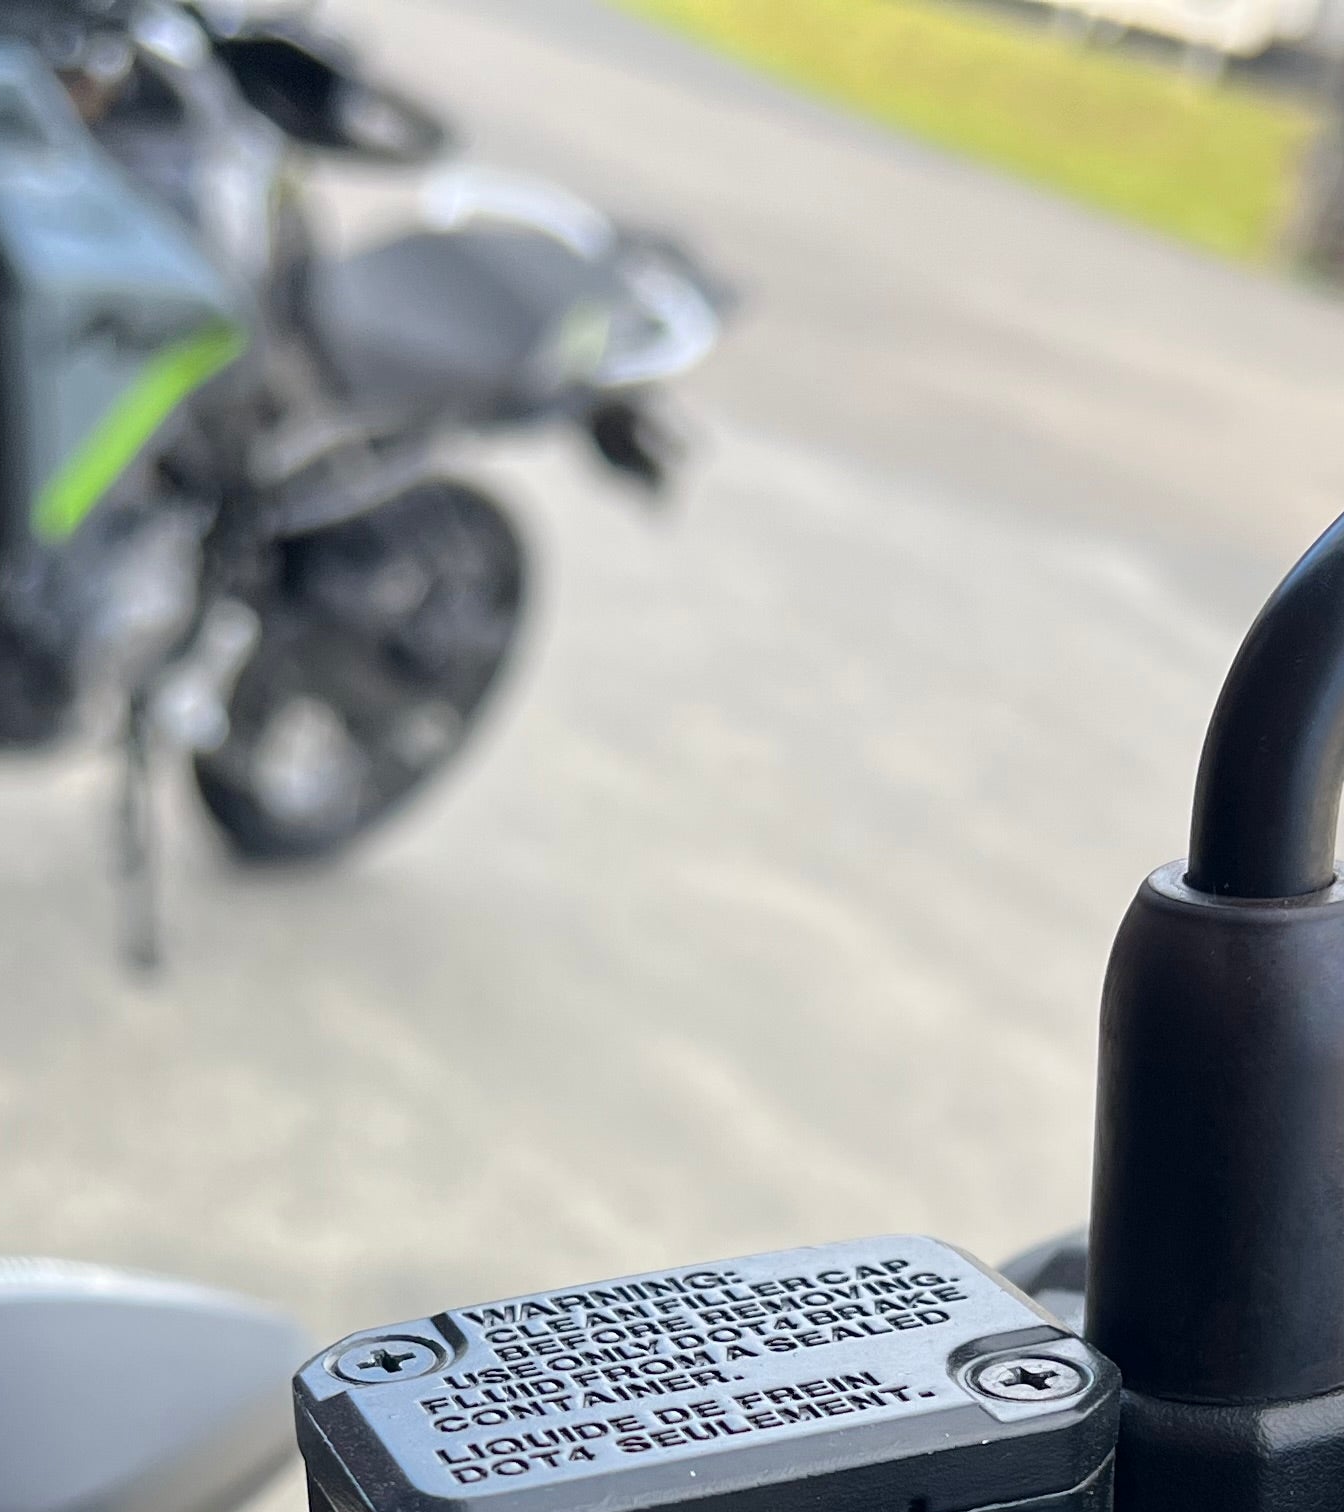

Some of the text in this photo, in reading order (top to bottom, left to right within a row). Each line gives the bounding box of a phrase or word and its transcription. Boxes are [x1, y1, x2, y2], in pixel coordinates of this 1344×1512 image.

[443, 1361, 543, 1389] USE
[547, 1340, 659, 1371] ONLY
[803, 1286, 968, 1326] BRAKE
[462, 1271, 744, 1327] WARNING:
[485, 1304, 651, 1344] CLEAN
[495, 1272, 960, 1362] BEFORE REMOVING.
[420, 1309, 951, 1415] FLUID FROM A SEALED
[433, 1370, 744, 1432] CONTAINER.
[436, 1372, 882, 1465] LIQUIDE DE FREIN
[451, 1386, 935, 1484] DOT4 SEULEMENT.
